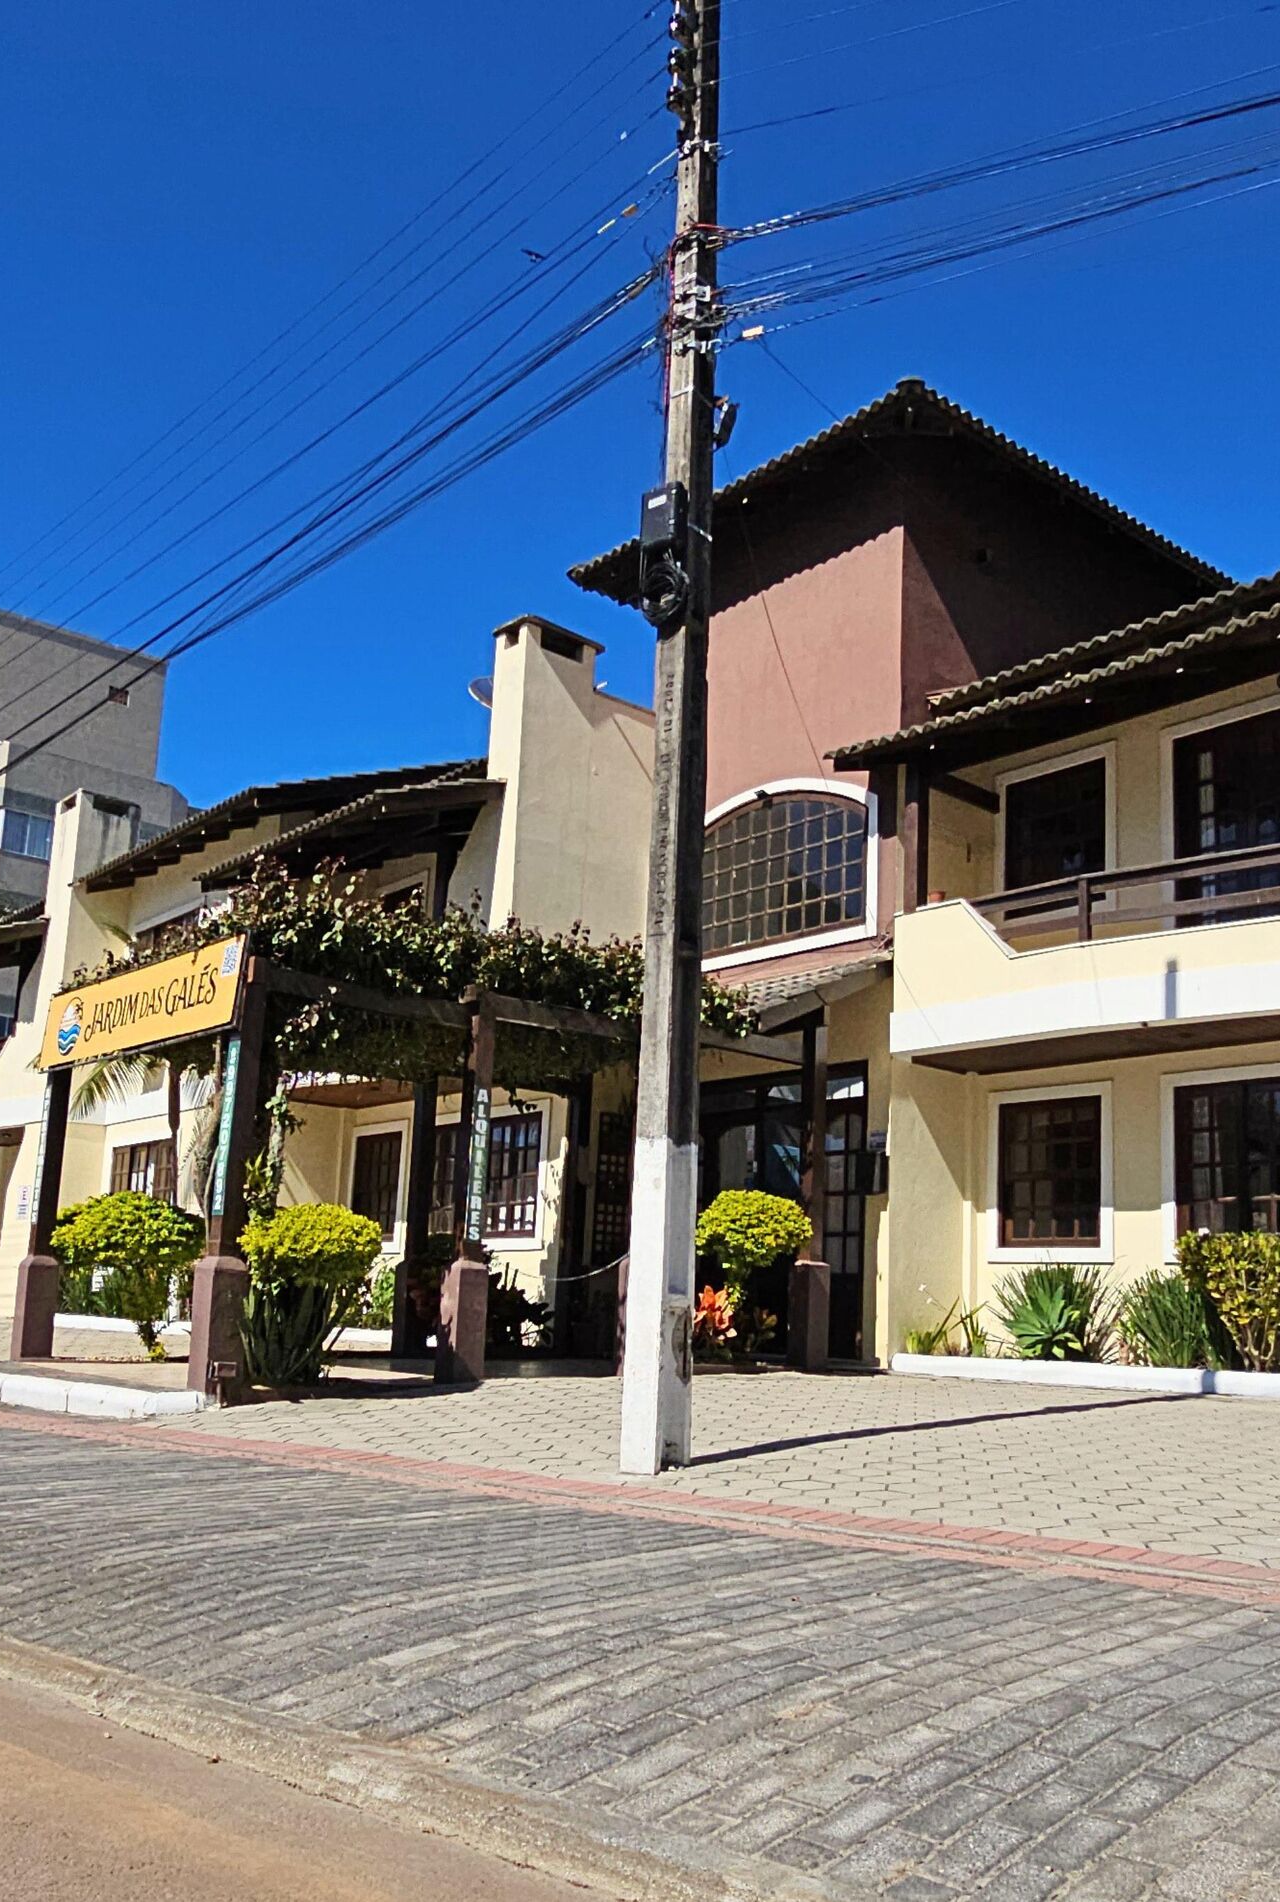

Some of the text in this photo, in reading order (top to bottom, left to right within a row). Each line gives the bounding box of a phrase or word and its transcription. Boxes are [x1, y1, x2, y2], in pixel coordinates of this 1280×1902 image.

[84, 963, 219, 1042] JARDIM DAS GALÉS
[468, 1088, 489, 1241] ALQUILERES
